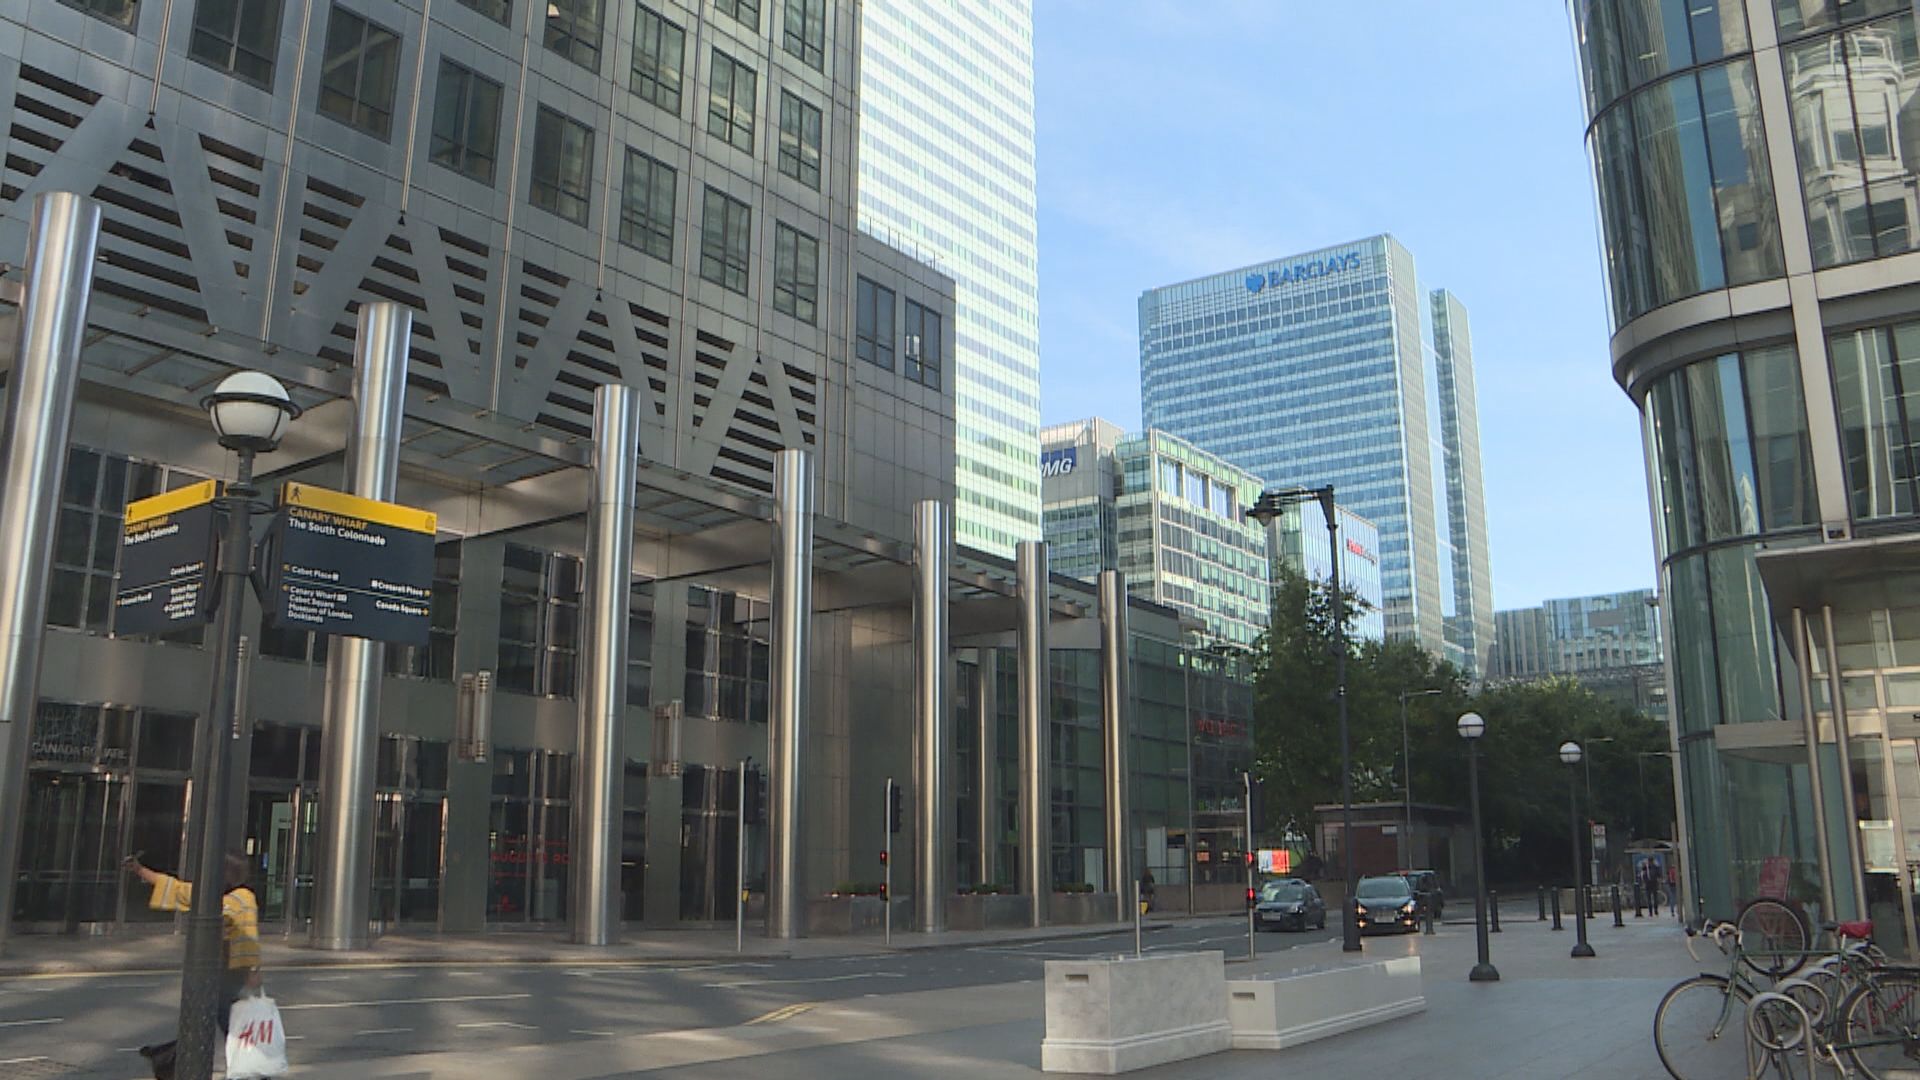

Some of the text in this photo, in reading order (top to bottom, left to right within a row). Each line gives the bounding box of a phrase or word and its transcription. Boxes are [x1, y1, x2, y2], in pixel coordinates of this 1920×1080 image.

[1267, 252, 1361, 288] BARCLAYS
[1041, 458, 1072, 478] MG
[289, 506, 368, 530] CANARY WHARF
[289, 518, 386, 546] The South Colonnade
[290, 586, 336, 600] Canary Wharf
